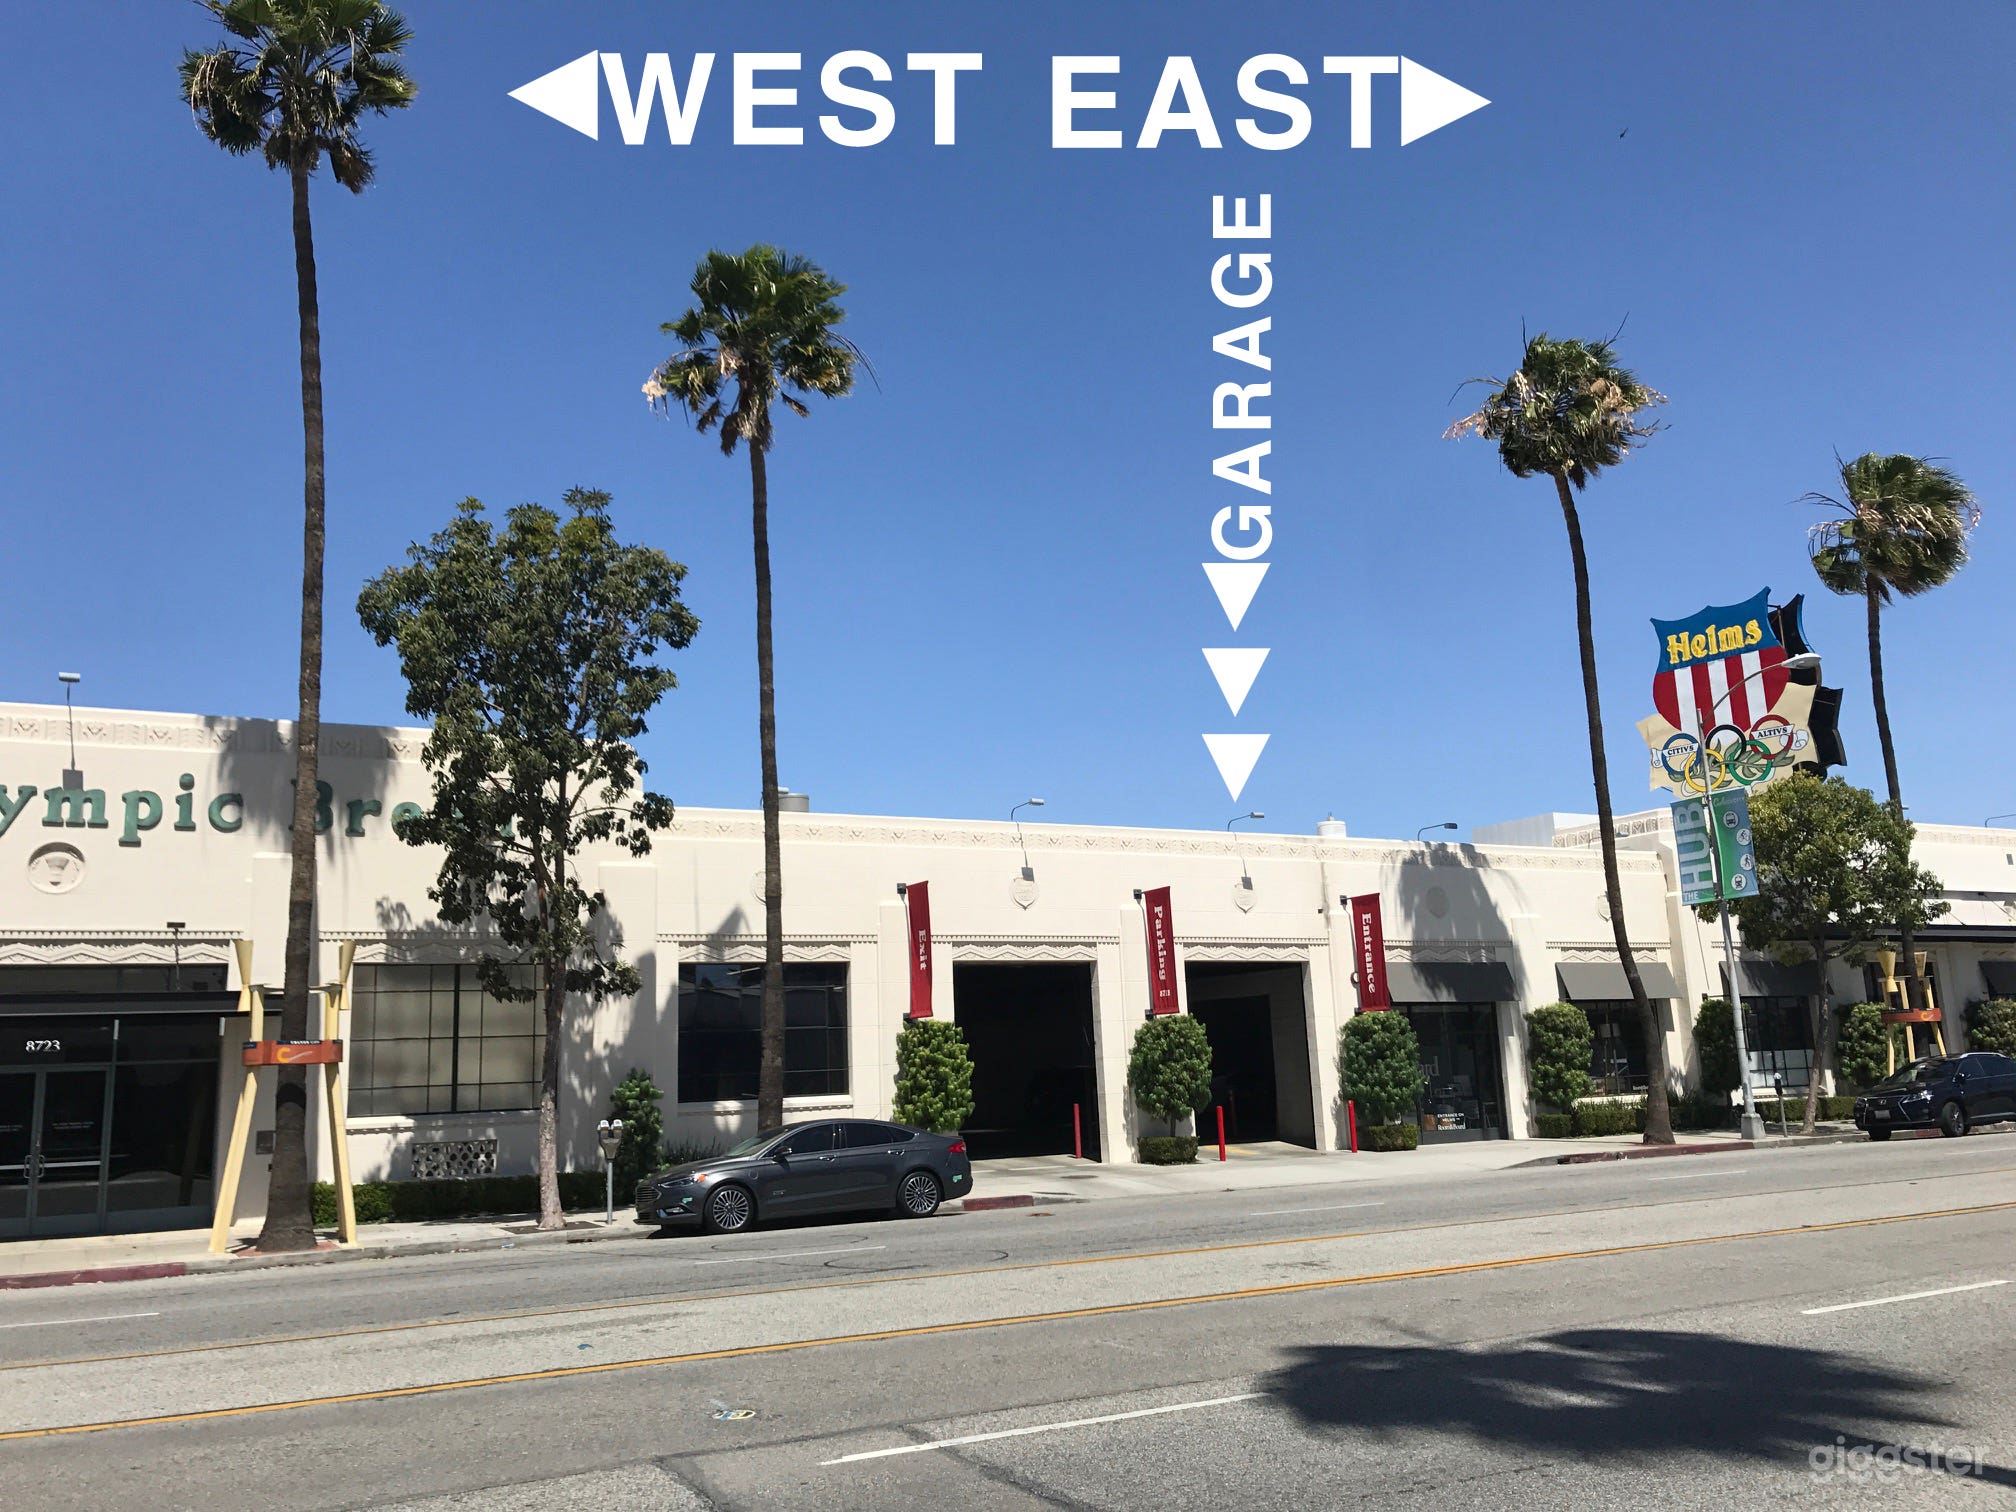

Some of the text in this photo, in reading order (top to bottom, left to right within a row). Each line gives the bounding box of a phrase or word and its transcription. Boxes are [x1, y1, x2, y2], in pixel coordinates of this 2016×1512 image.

[1667, 619, 1762, 664] Helms
[1667, 745, 1694, 755] CITIVS
[1757, 726, 1787, 738] ALTIVS
[1674, 802, 1714, 892] HUB
[1684, 892, 1699, 902] THE
[919, 929, 927, 971] Exit
[1154, 906, 1166, 980] Parking
[1362, 913, 1375, 993] Entrance
[25, 1040, 61, 1052] 8723
